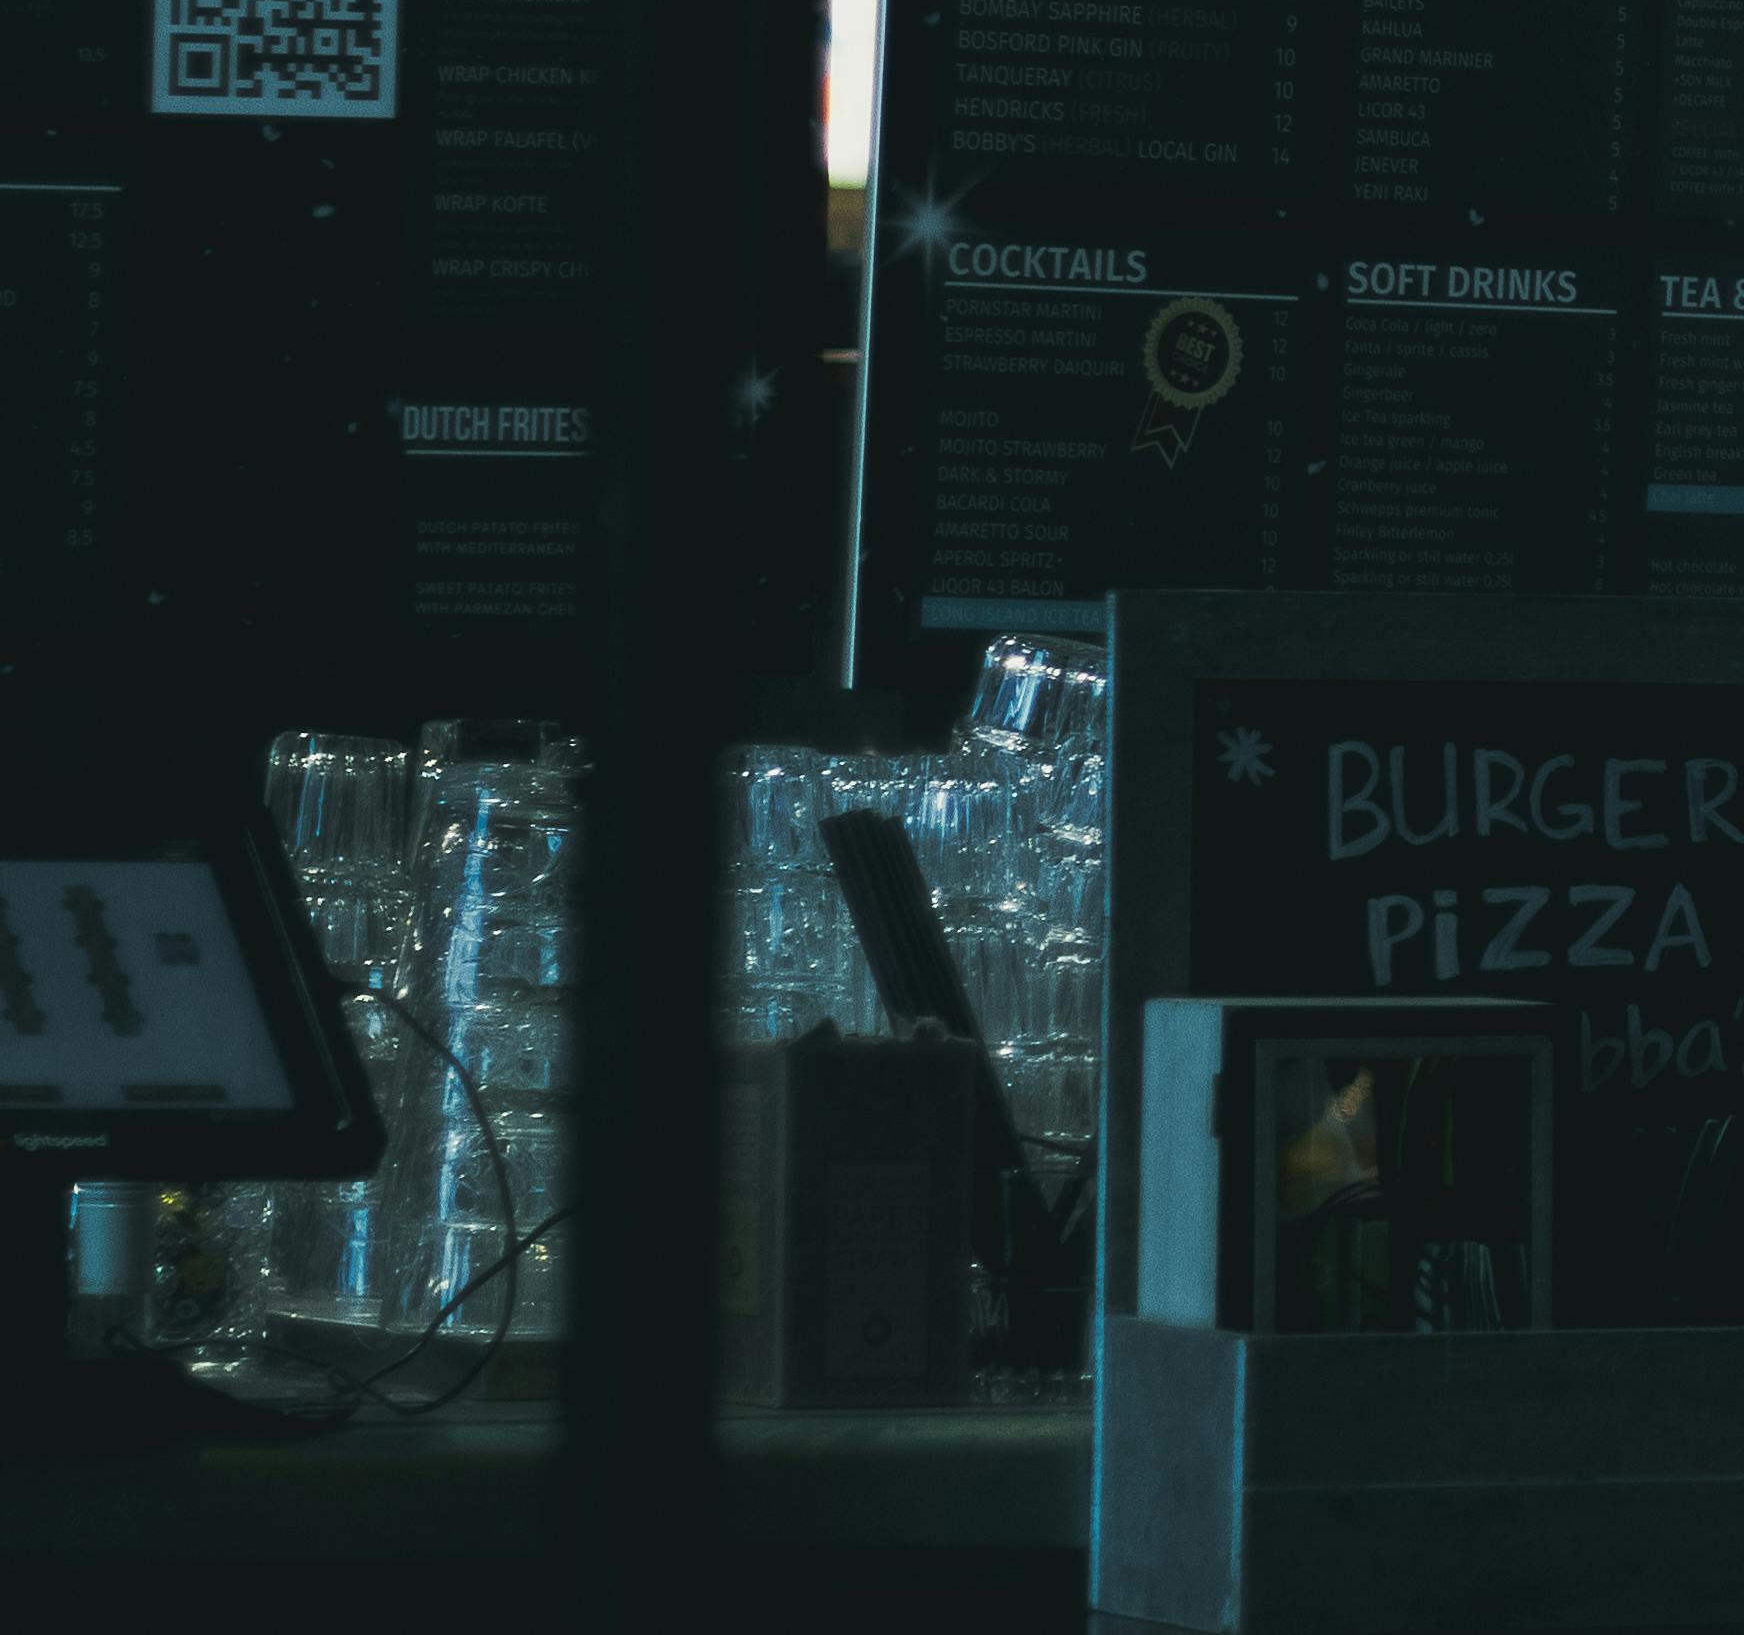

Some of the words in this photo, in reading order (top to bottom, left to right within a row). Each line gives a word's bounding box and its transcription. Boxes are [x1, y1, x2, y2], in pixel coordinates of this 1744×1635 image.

[1138, 139, 1197, 162] LOCAL
[1204, 142, 1239, 164] GIN
[948, 242, 1148, 283] COCKTAILS
[1347, 261, 1437, 297] SOFT
[1448, 265, 1578, 303] DRINKS
[1660, 274, 1722, 309] TEA
[1174, 332, 1216, 364] BEST
[402, 406, 489, 442] DUTCH
[498, 407, 591, 443] FRITES
